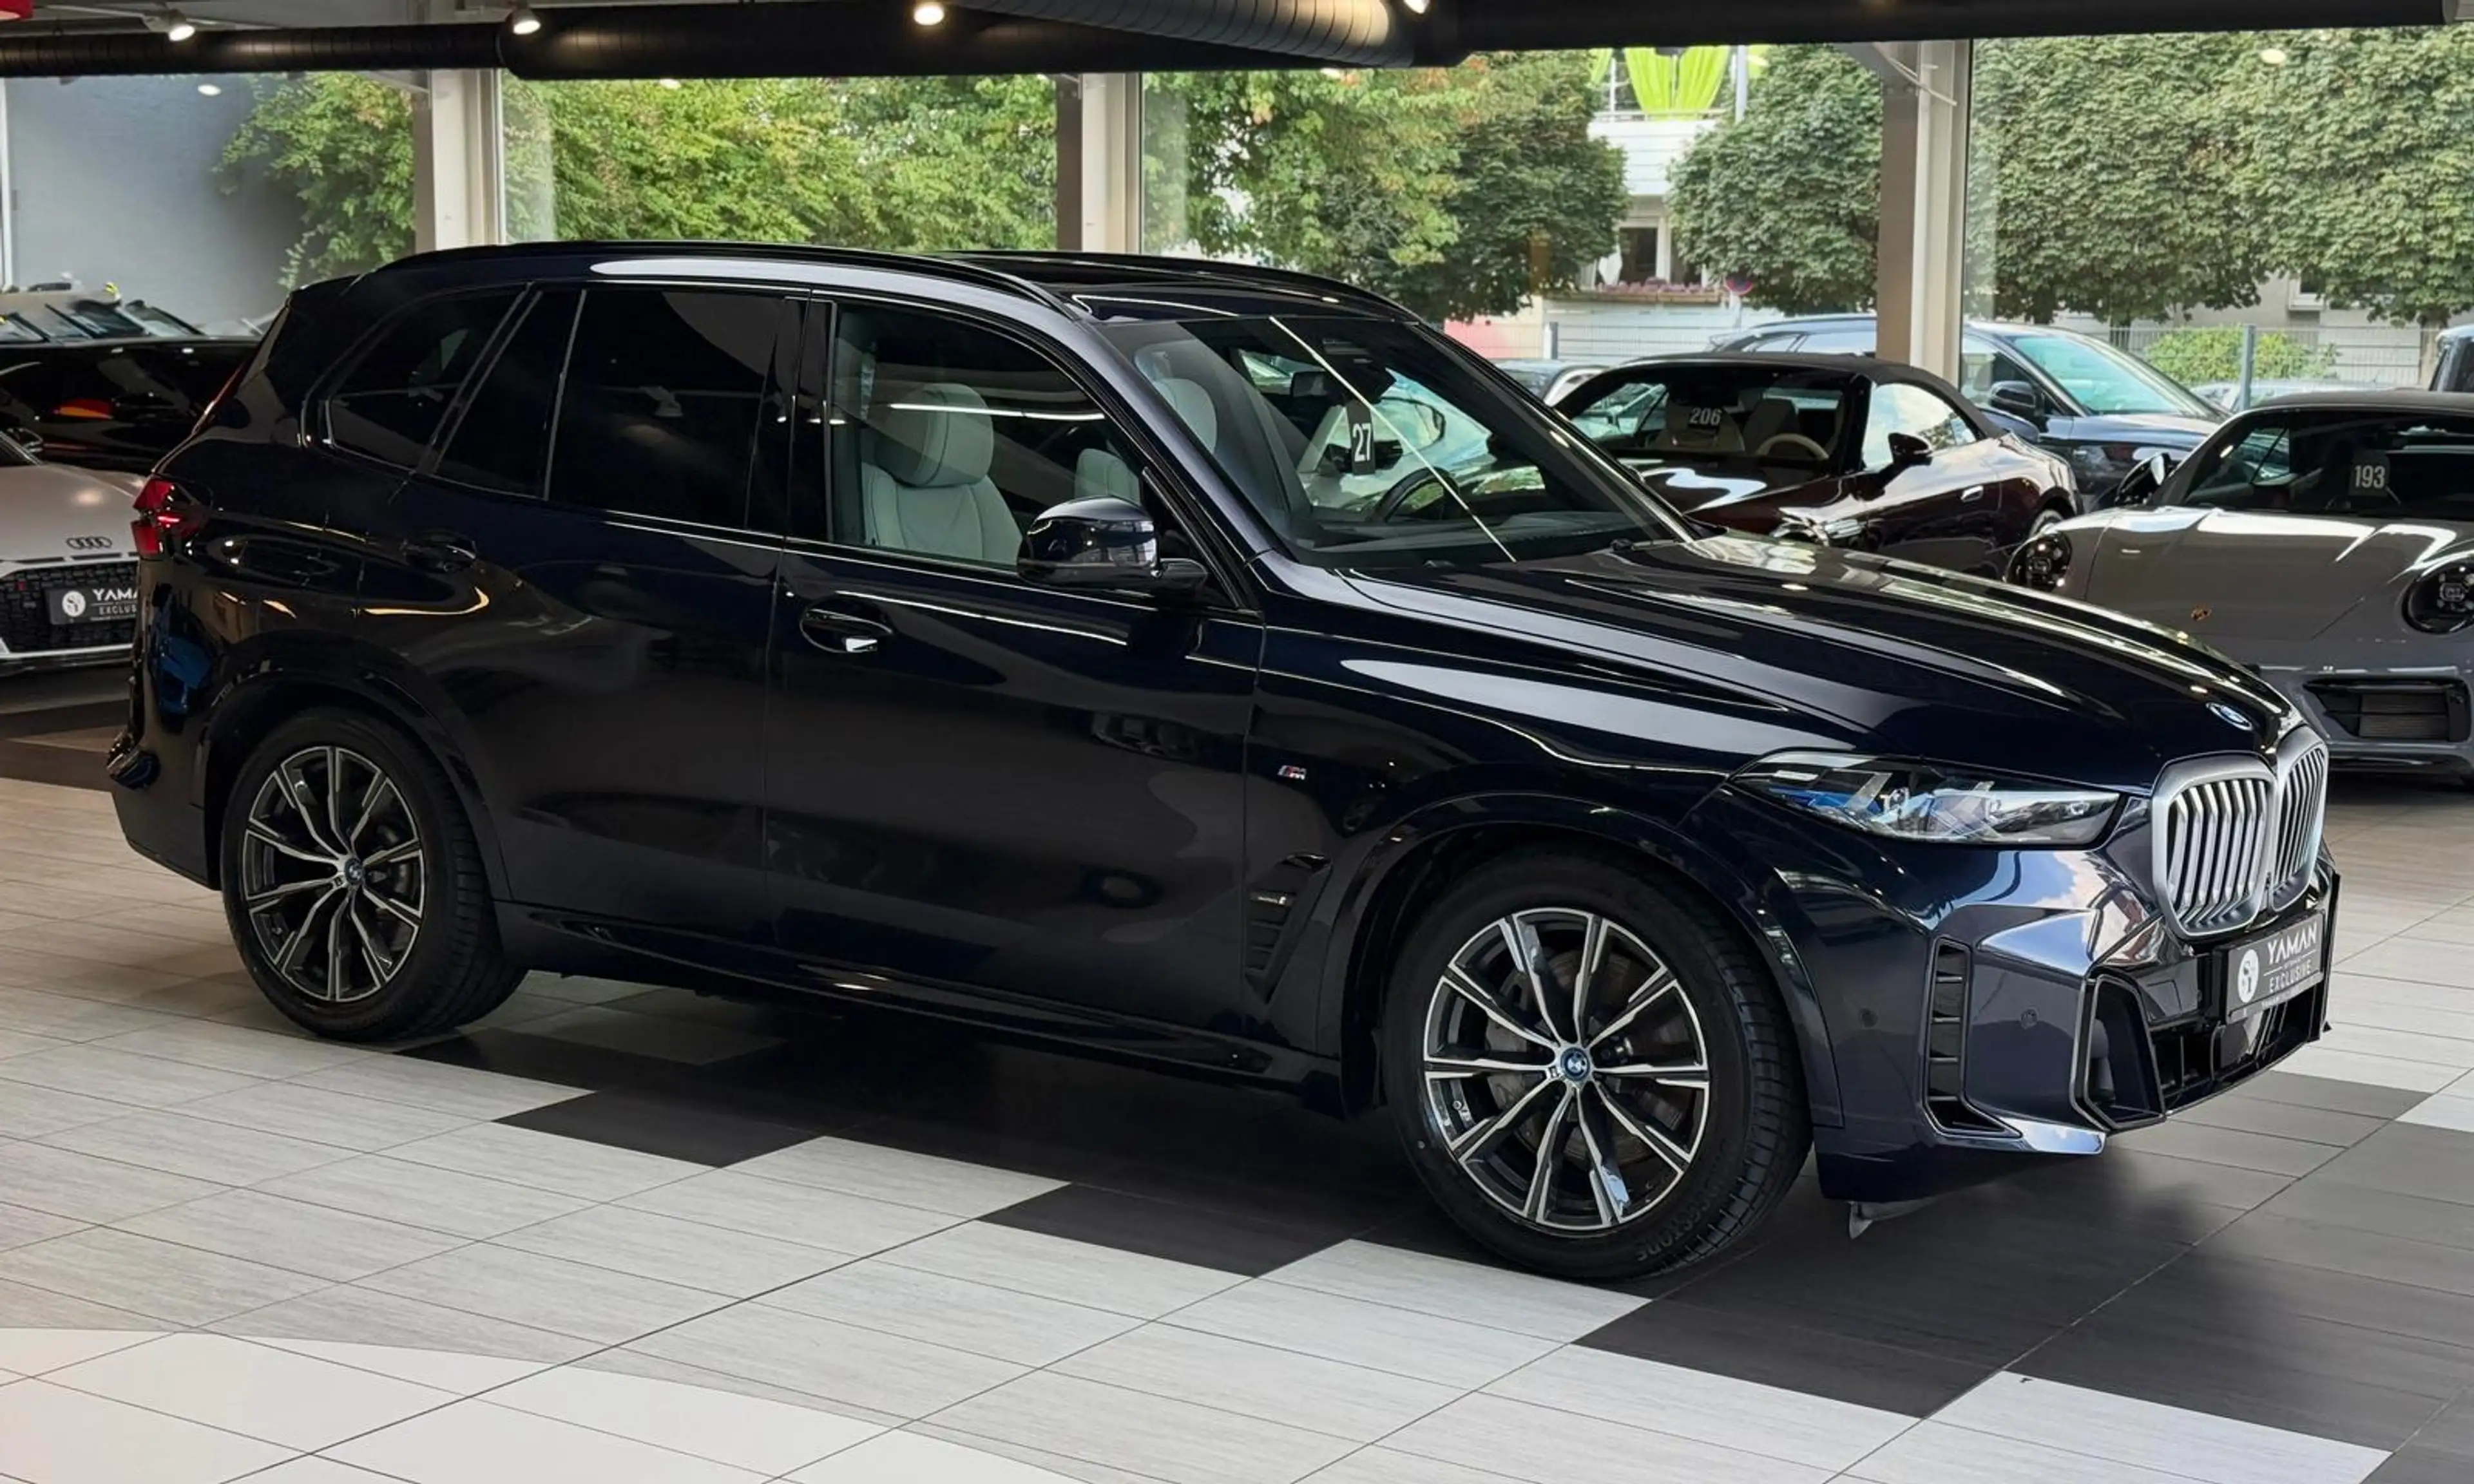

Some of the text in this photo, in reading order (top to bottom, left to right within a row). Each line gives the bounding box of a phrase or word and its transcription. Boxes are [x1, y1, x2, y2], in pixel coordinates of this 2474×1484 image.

[1689, 407, 1722, 425] 206
[1353, 423, 1371, 462] 27
[2354, 464, 2385, 490] 193
[2267, 920, 2317, 965] YAMAN
